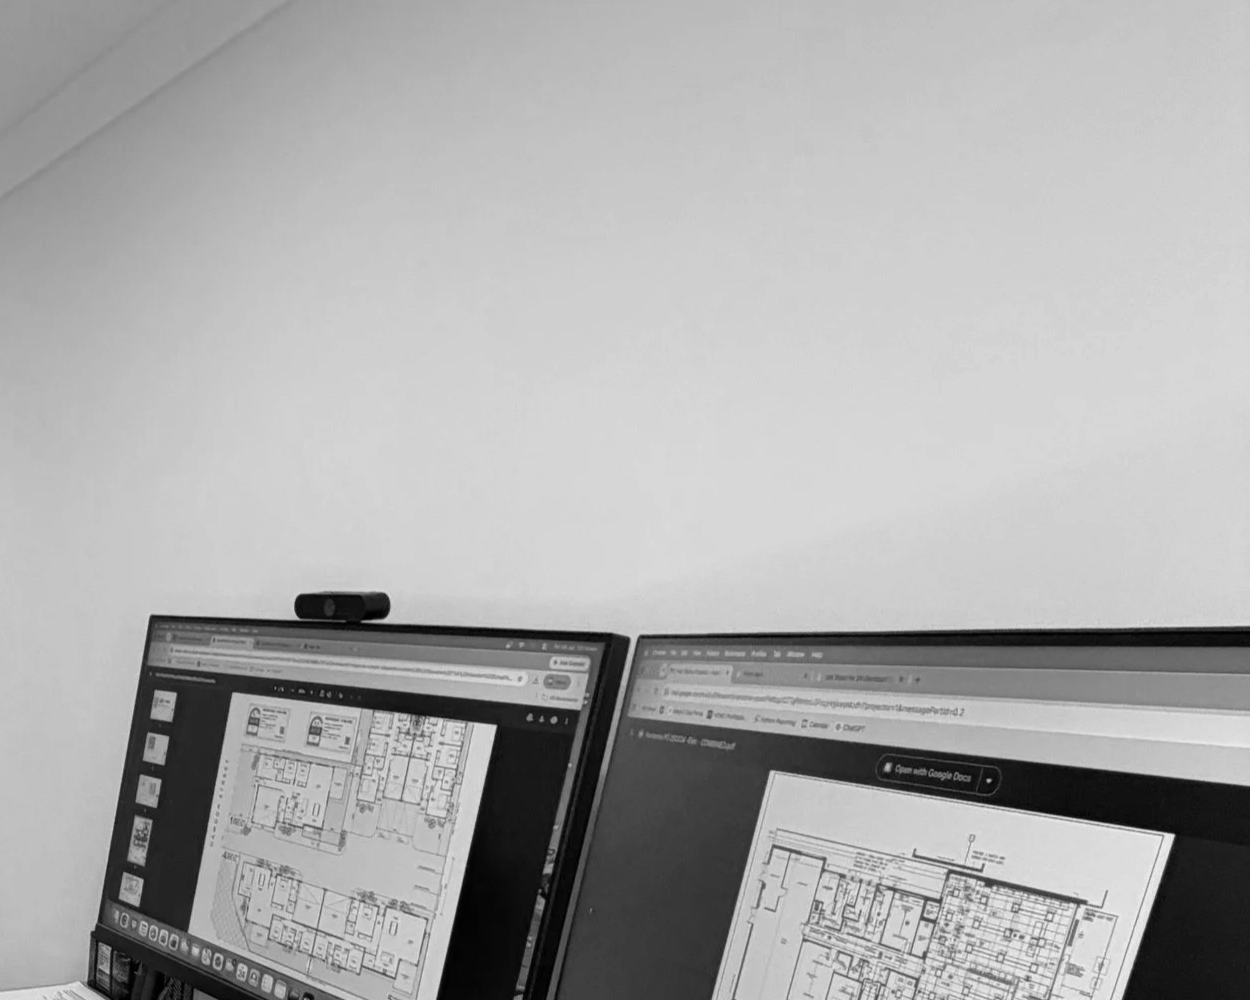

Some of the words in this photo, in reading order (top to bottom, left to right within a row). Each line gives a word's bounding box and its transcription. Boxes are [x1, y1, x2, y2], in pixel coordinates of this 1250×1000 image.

[894, 764, 912, 775] Open
[912, 766, 928, 777] with
[928, 768, 952, 781] Google
[953, 771, 972, 783] Docs
